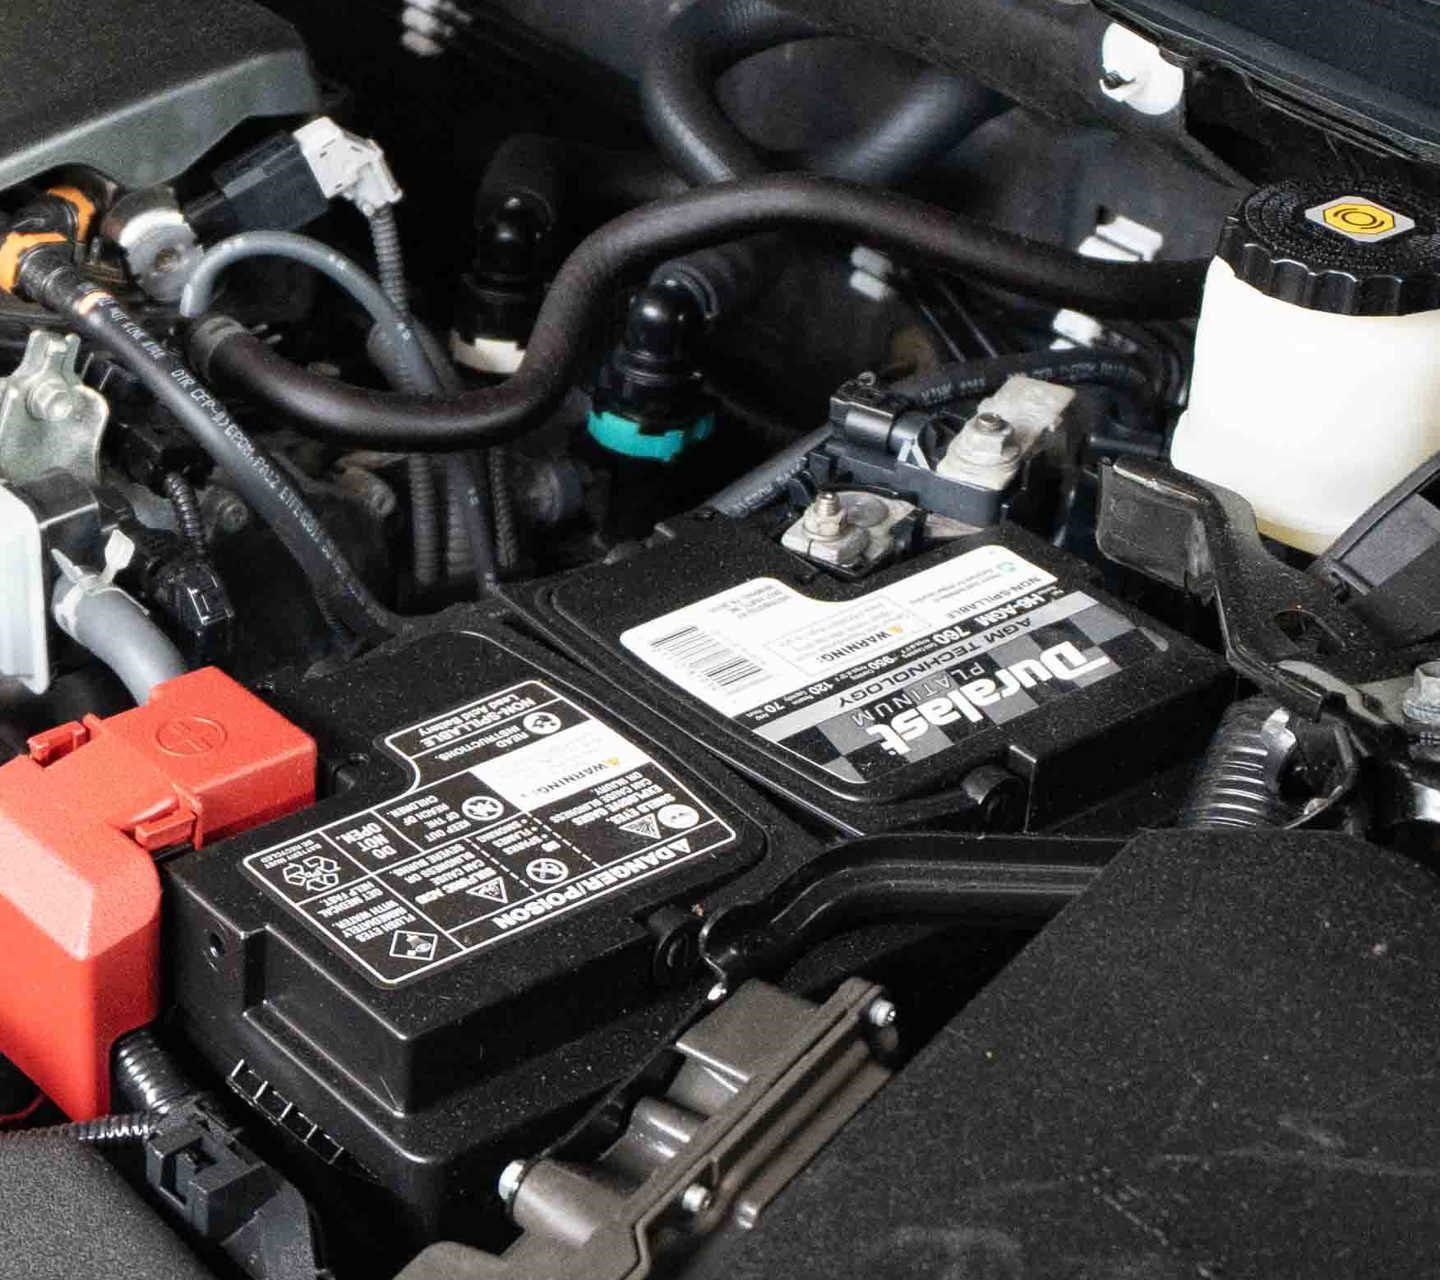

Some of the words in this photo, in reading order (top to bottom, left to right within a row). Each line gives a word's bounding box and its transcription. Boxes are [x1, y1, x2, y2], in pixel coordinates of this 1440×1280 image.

[971, 592, 1047, 627] H6-AGM
[928, 623, 974, 646] 760
[979, 616, 1037, 643] AGM
[828, 640, 983, 708] TECHNOLOGY
[804, 679, 838, 696] 120
[842, 660, 990, 727] PLATINUM
[856, 636, 1114, 756] Duralast
[458, 704, 490, 720] Acid
[485, 692, 520, 709] Lead
[760, 700, 787, 714] 70
[414, 714, 463, 738] Battery
[417, 695, 536, 749] NON-SPILLABLE
[431, 722, 522, 764] INSTRUCTIONS.
[492, 730, 530, 748] READ
[332, 820, 384, 846] OPEN.
[352, 832, 390, 853] NOT
[368, 843, 399, 860] DO
[515, 844, 677, 919] DANGER/POISON
